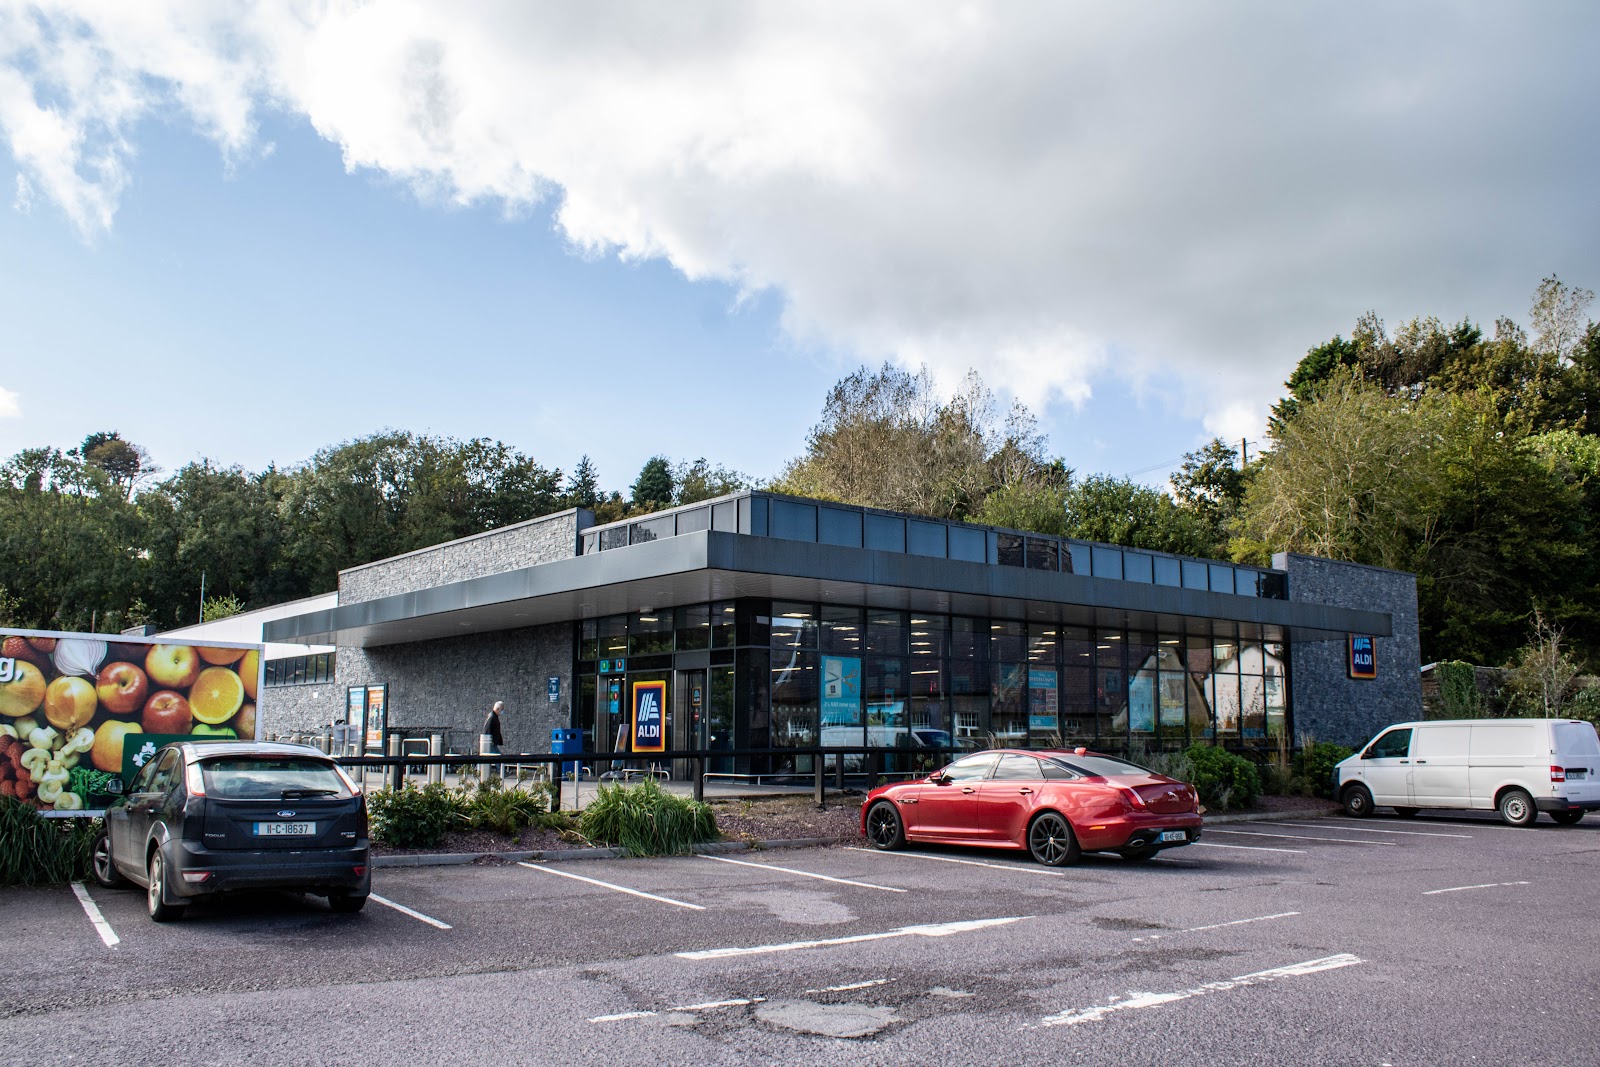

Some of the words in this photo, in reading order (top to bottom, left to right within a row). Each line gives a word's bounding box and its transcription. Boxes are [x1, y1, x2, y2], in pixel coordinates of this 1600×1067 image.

[1354, 653, 1372, 665] ALDI
[637, 725, 659, 737] ALDI
[266, 824, 309, 834] 11-C-18637
